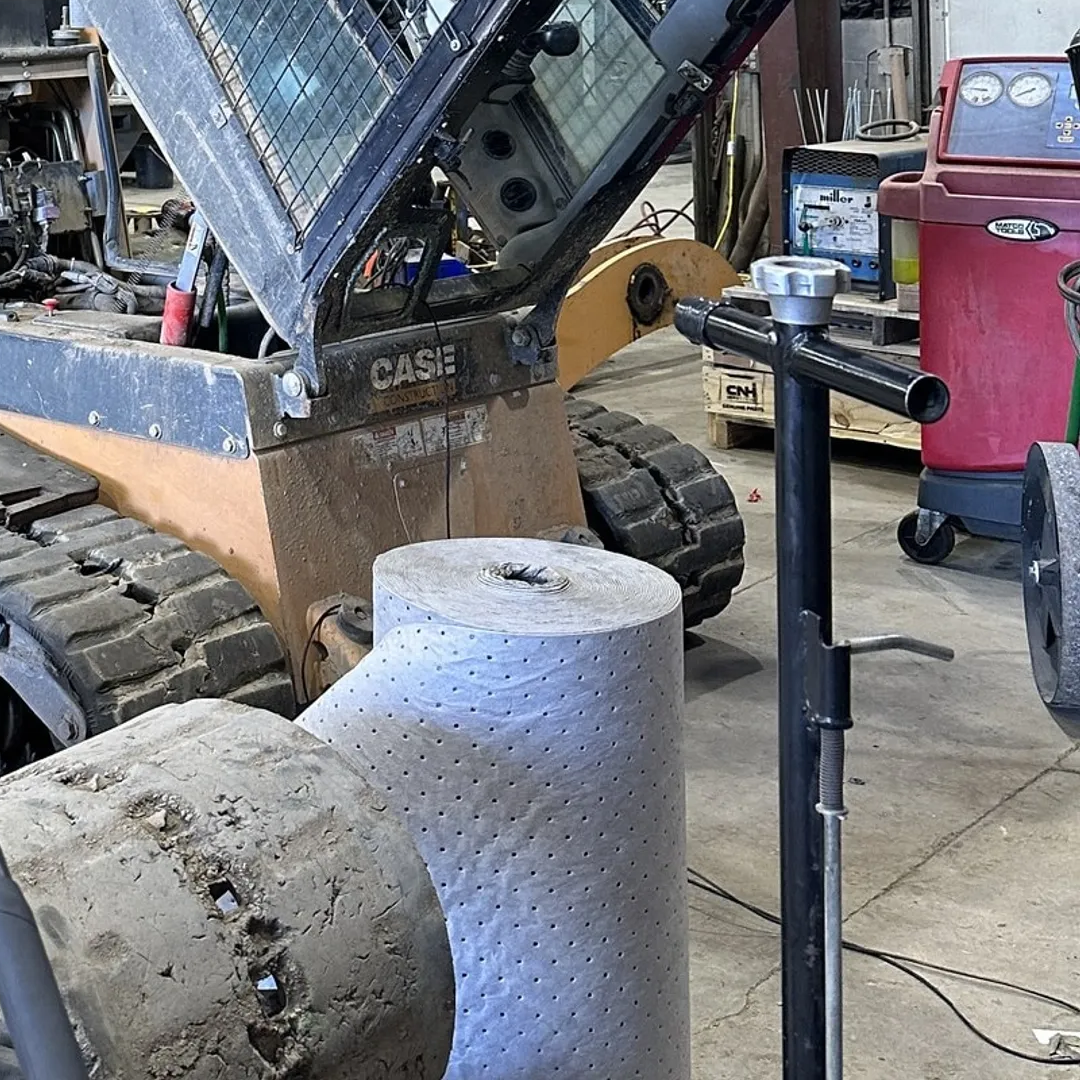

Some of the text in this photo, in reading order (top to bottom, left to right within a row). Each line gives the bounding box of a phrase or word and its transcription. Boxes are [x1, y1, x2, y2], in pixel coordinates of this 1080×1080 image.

[820, 189, 853, 204] miller
[371, 344, 456, 390] CASE
[383, 381, 456, 406] CONSTRUCTN
[726, 382, 756, 398] CNH
